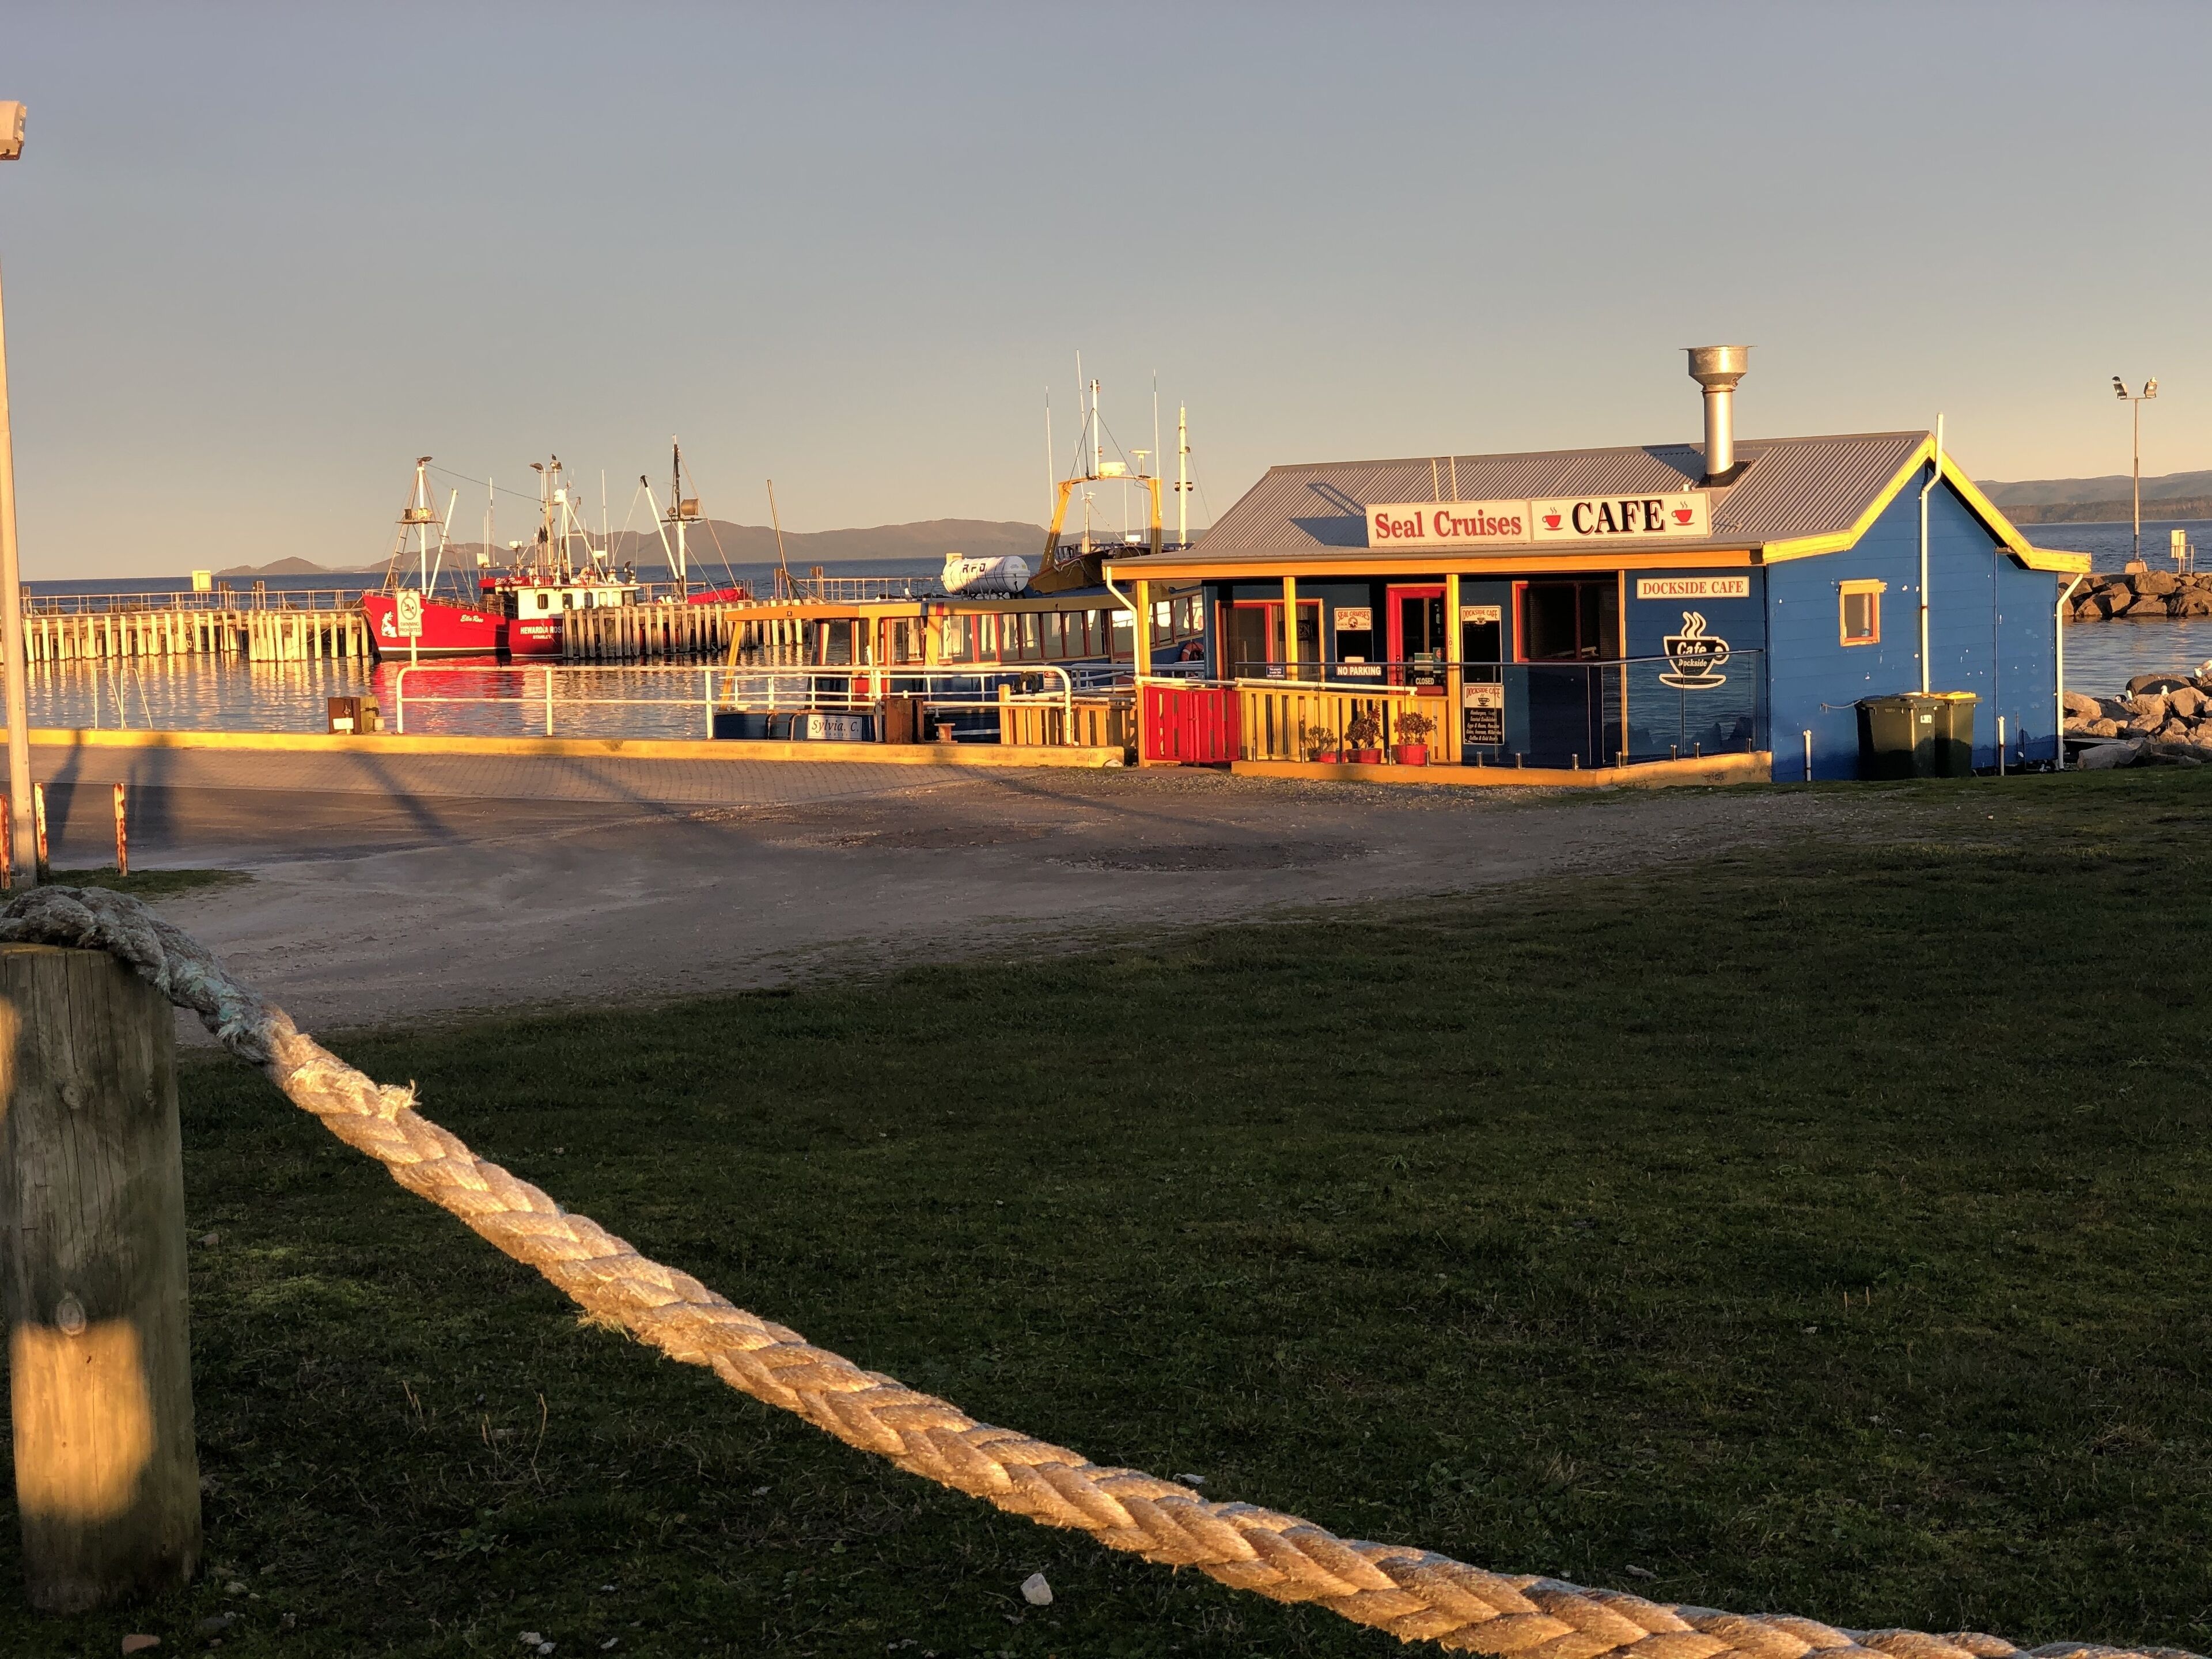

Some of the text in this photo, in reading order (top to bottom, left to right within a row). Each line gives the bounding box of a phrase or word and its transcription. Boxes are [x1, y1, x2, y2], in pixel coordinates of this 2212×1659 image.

[1571, 499, 1666, 536] CAFE
[1374, 509, 1522, 539] Seal Cruises
[1643, 581, 1744, 594] DOCKSIDE CAFE
[1338, 611, 1370, 622] SEAL CRUISES
[1463, 609, 1498, 620] DOCKSIDE CAFE
[550, 626, 563, 634] ROS
[1678, 658, 1707, 667] Dockside
[1337, 666, 1381, 676] NO PARKING
[1466, 687, 1500, 699] DOCKSIDE CAFE
